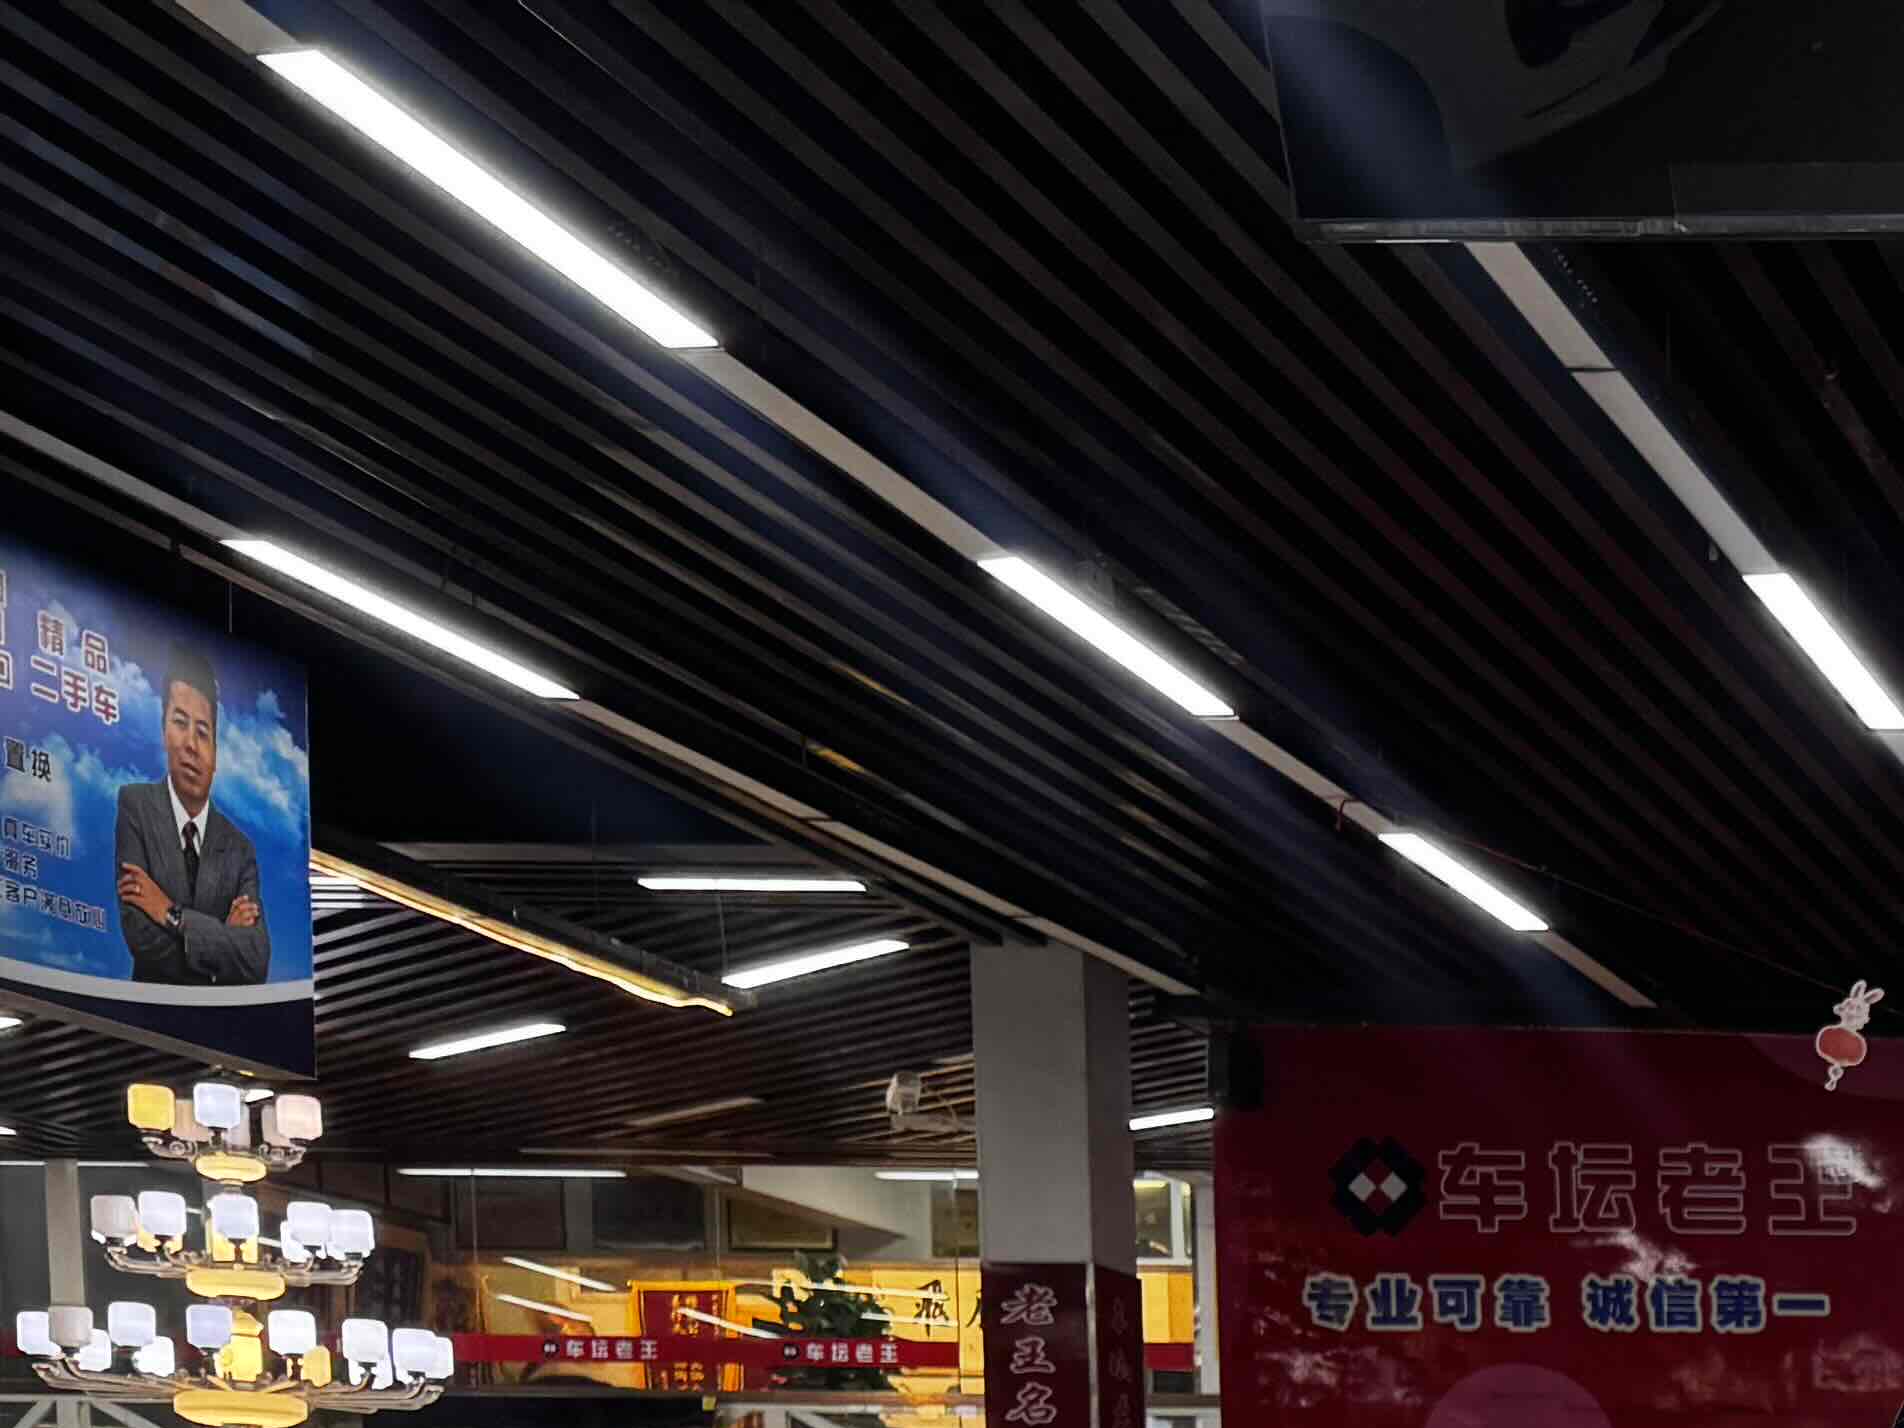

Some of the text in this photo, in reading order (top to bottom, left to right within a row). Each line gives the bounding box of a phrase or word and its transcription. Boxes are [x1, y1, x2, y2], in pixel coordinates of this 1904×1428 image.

[37, 609, 111, 675] 精品
[31, 656, 120, 725] 二手车
[1438, 1141, 1857, 1238] 车坛老王
[1302, 1273, 1832, 1333] 专业可靠 诚信第一
